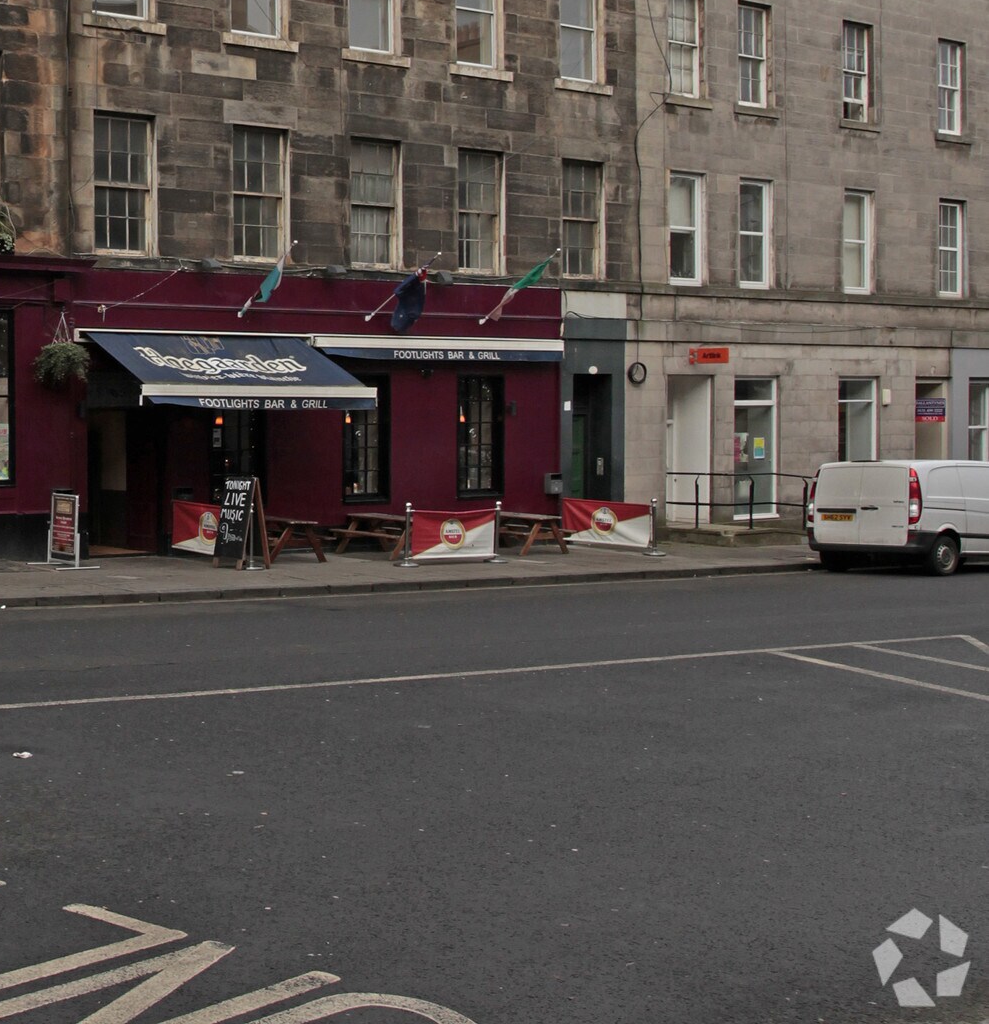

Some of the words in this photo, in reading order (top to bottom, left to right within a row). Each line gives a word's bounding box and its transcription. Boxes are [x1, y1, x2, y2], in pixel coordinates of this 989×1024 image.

[133, 346, 307, 375] Hoegaarden
[393, 350, 444, 360] FOOTLIGHTS
[447, 352, 464, 360] BAR
[468, 352, 476, 360] &
[477, 351, 501, 360] GRILL
[198, 398, 260, 409] FOOTLIGHTS
[264, 399, 285, 409] BAR
[290, 400, 297, 409] &
[302, 400, 328, 409] GRILL
[225, 480, 251, 491] TONIGHT
[224, 492, 247, 507] LIVE
[220, 508, 244, 523] MUSIC
